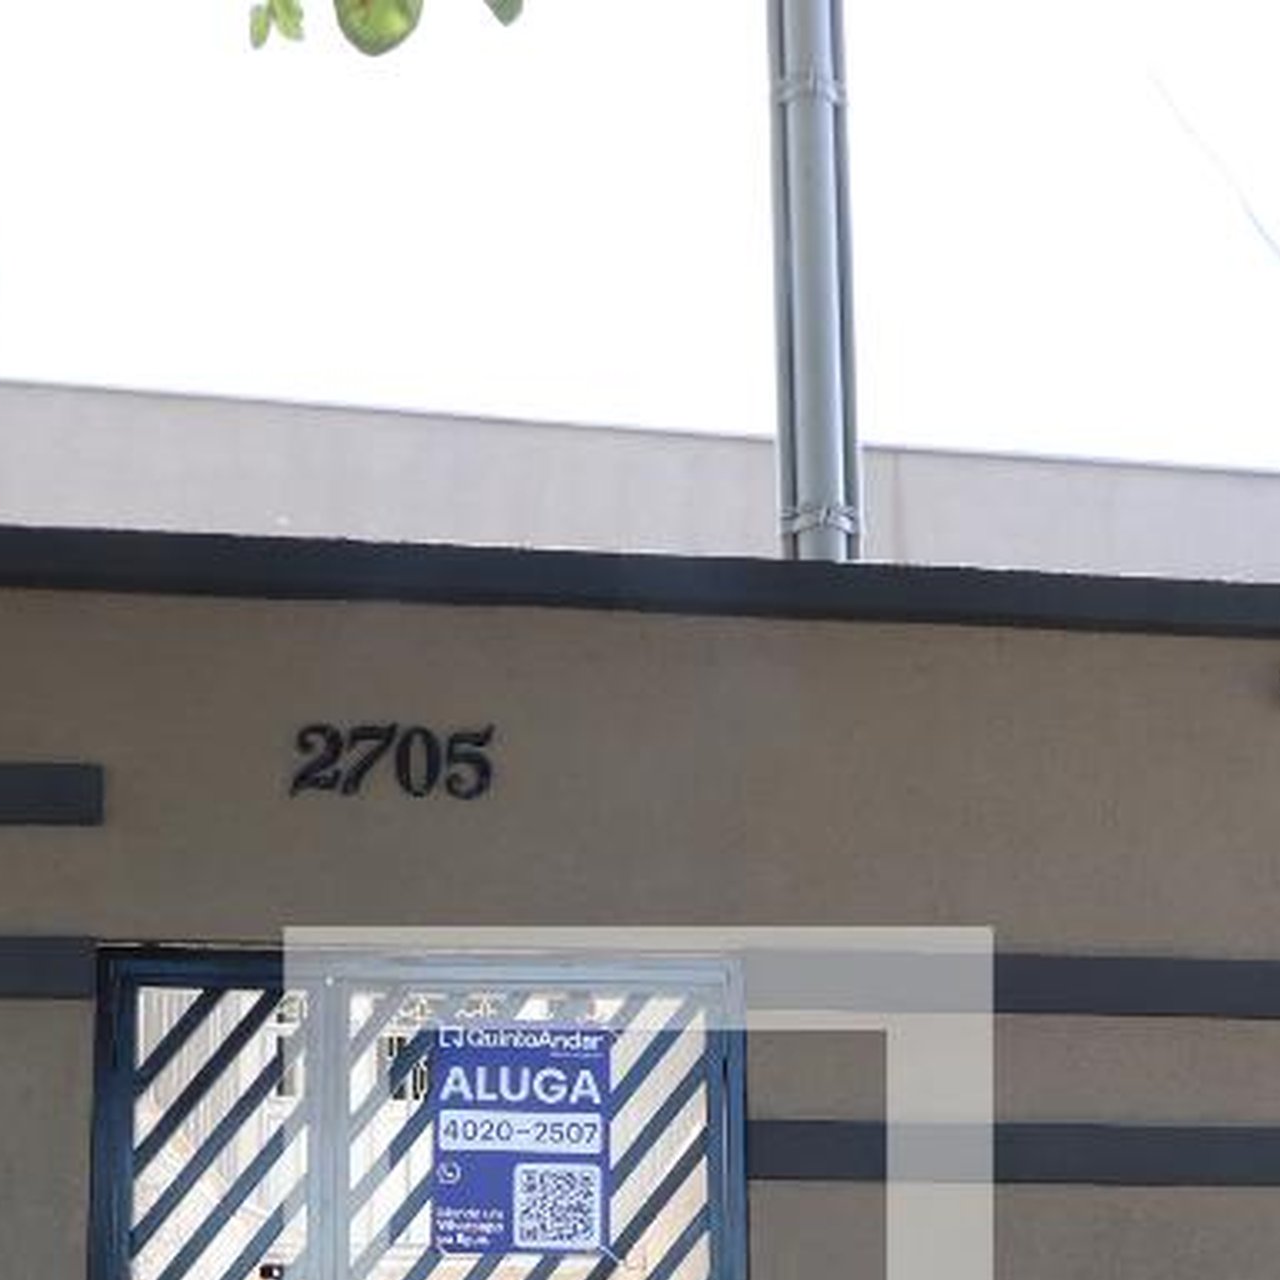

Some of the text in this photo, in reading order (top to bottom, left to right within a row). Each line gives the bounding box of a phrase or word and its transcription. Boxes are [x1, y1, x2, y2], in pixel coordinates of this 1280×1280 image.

[289, 722, 495, 799] 2705
[466, 1027, 603, 1051] QuintoAndar
[440, 1066, 601, 1104] ALUGA
[443, 1119, 598, 1144] 4020-2507
